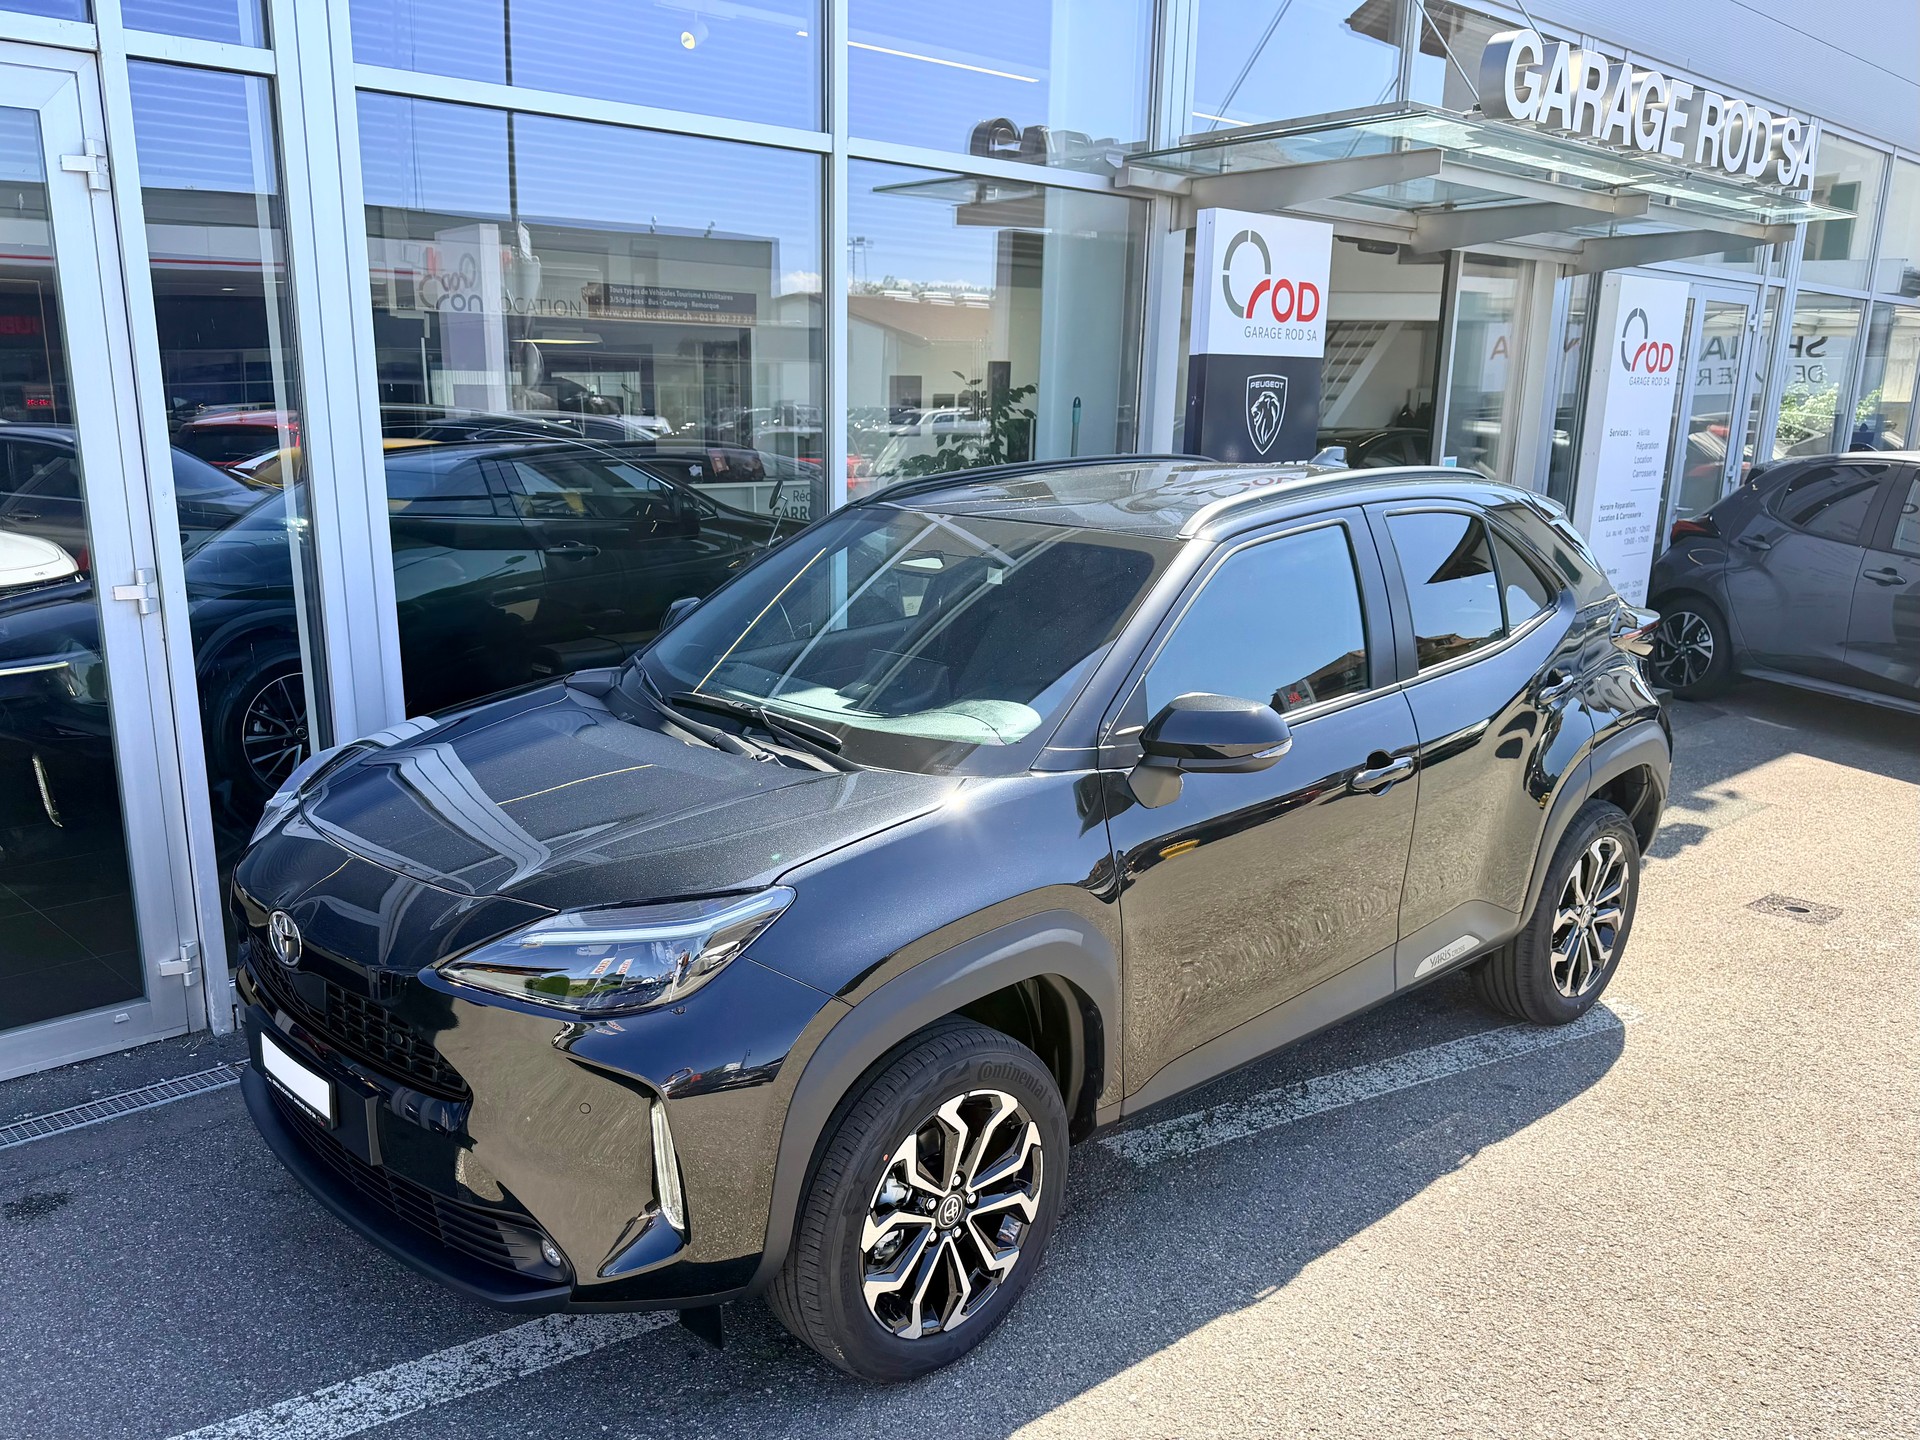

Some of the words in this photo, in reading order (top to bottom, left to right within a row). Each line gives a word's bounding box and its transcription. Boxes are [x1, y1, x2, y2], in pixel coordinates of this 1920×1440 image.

[1504, 28, 1694, 159] GARAGE
[1696, 90, 1773, 177] ROD
[1777, 117, 1816, 191] SA
[609, 286, 624, 294] Tous
[624, 286, 640, 297] types
[641, 287, 648, 296] de
[649, 287, 676, 298] Véhicules
[676, 290, 701, 299] Tourisme
[707, 292, 734, 301] Utilitaires
[625, 296, 645, 306] places
[648, 298, 659, 306] Bus
[663, 299, 688, 309] Camping
[691, 301, 720, 311] Remorque
[596, 308, 692, 321] www.oronlocation.ch
[1244, 325, 1282, 340] GARAGE
[1285, 326, 1304, 341] ROD
[1307, 328, 1318, 342] SA
[1249, 380, 1285, 390] PEUGEOT
[1629, 376, 1650, 386] GARAGE
[1650, 377, 1663, 386] ROD
[1664, 377, 1670, 386] SA
[1634, 455, 1653, 465] Location
[1632, 469, 1657, 478] Carrosserie
[977, 1060, 1049, 1100] Continental
